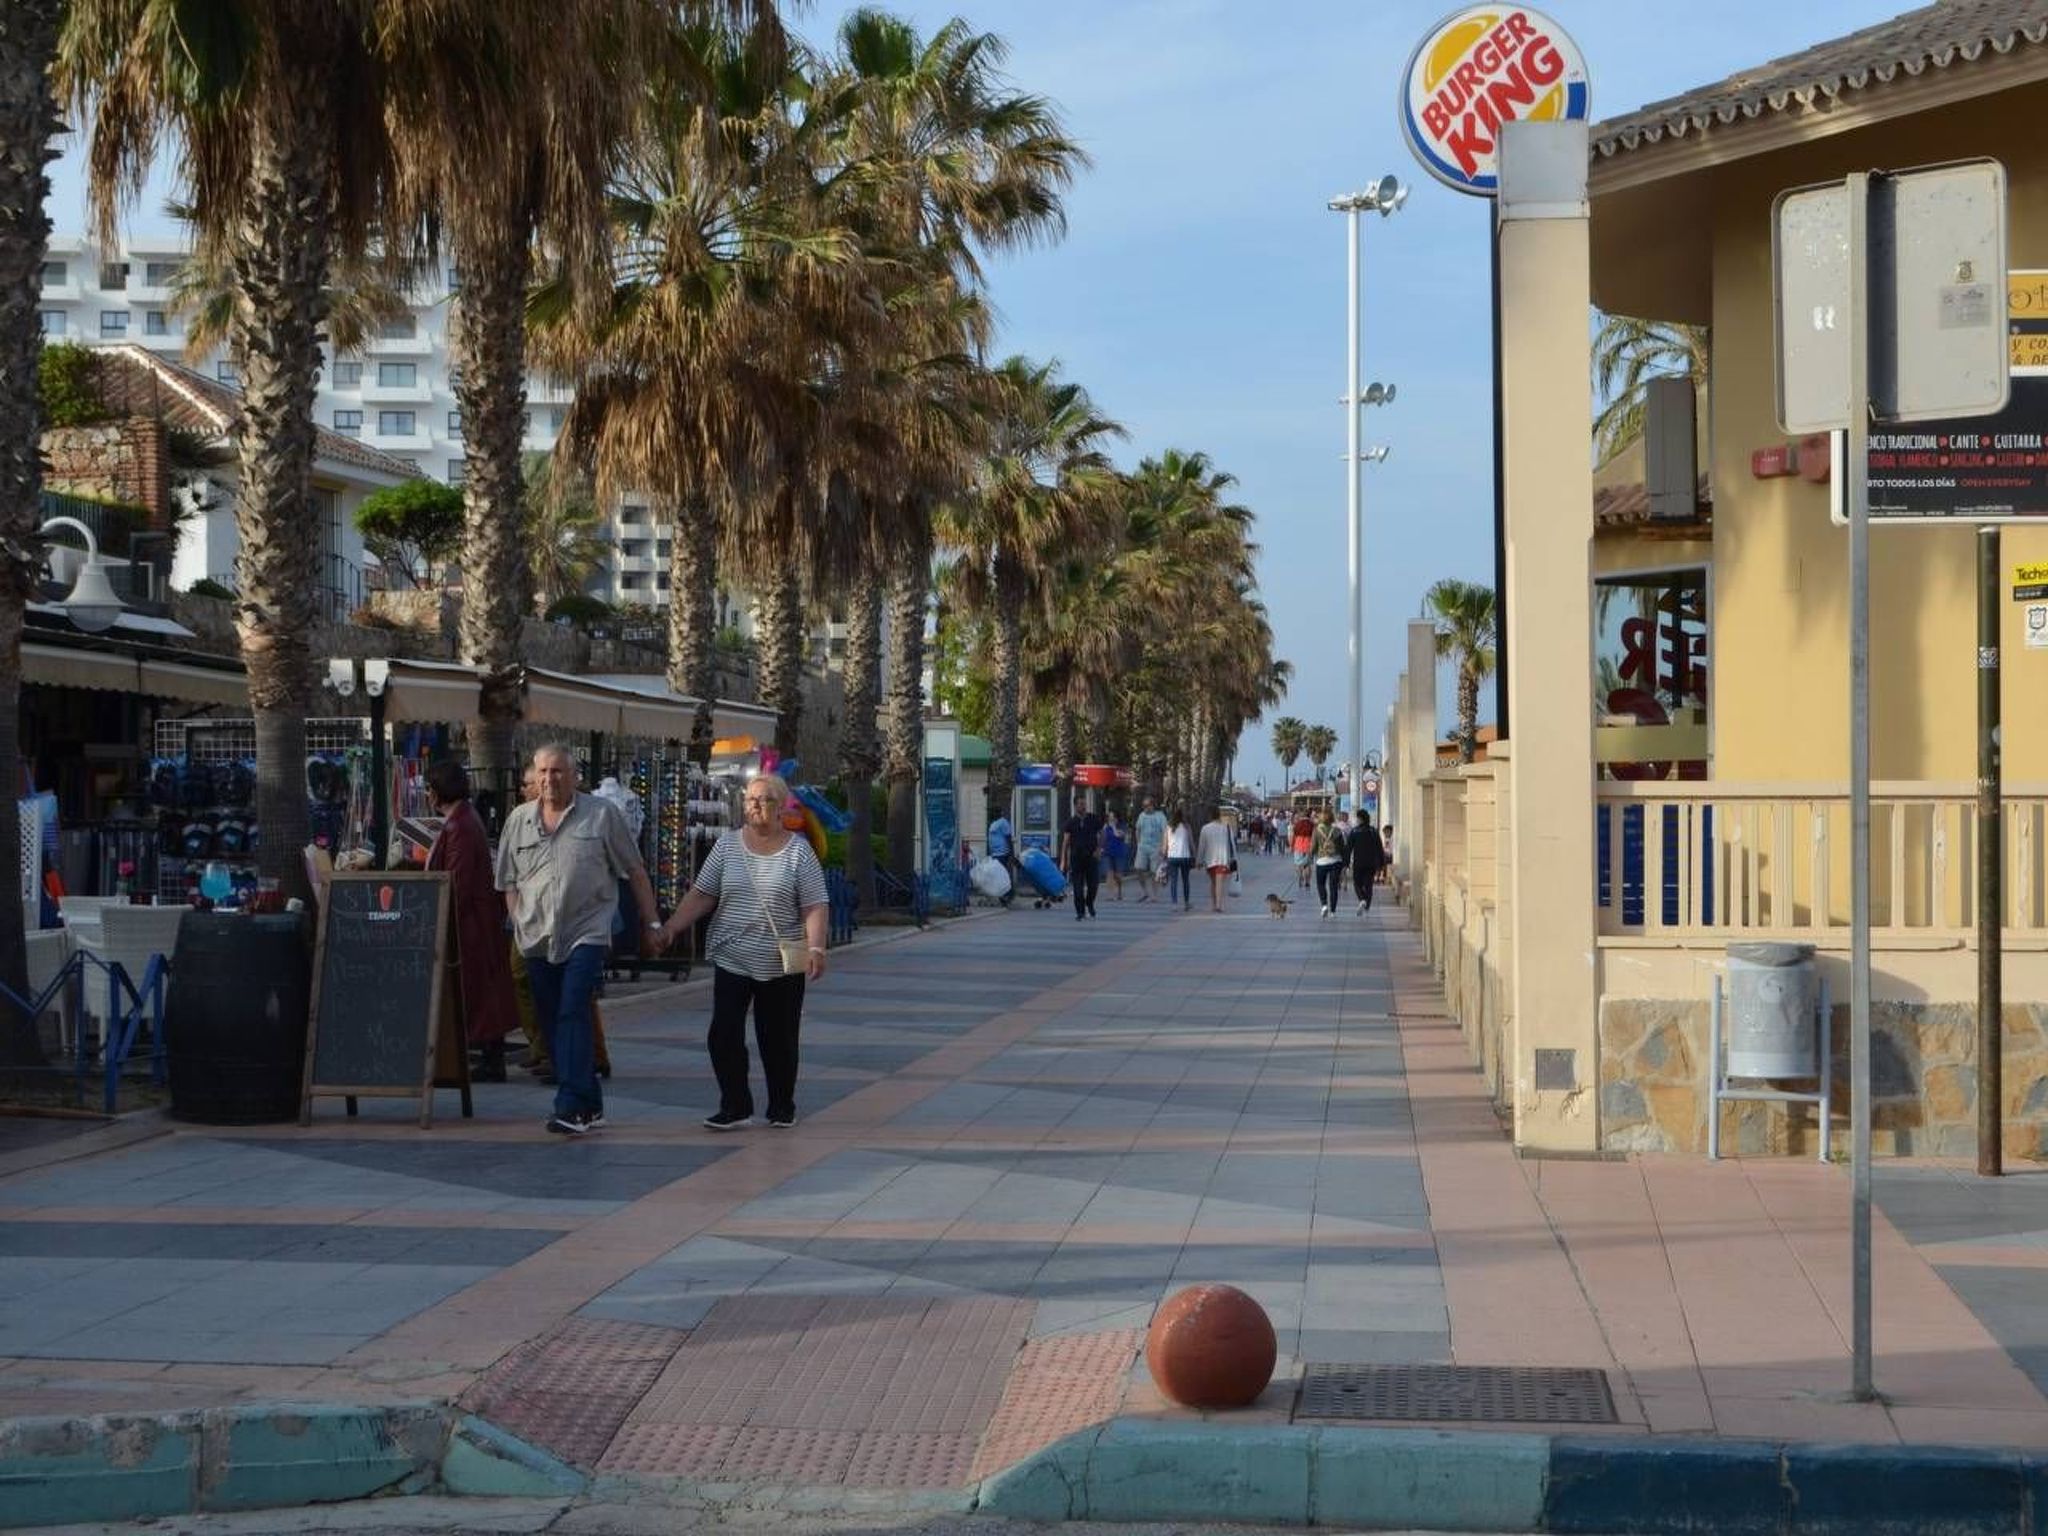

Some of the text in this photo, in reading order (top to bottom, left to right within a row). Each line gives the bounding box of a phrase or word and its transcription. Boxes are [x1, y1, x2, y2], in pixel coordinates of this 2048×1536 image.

[1421, 12, 1537, 142] BURGER
[1446, 35, 1564, 180] KING
[1888, 434, 1938, 449] TRADICIONAL
[1949, 434, 1979, 449] CANTE
[1994, 434, 2042, 449] GUITARRA
[1886, 479, 1916, 488] TODOS
[1917, 479, 1935, 488] LOS
[1935, 476, 1956, 488] DÍAS
